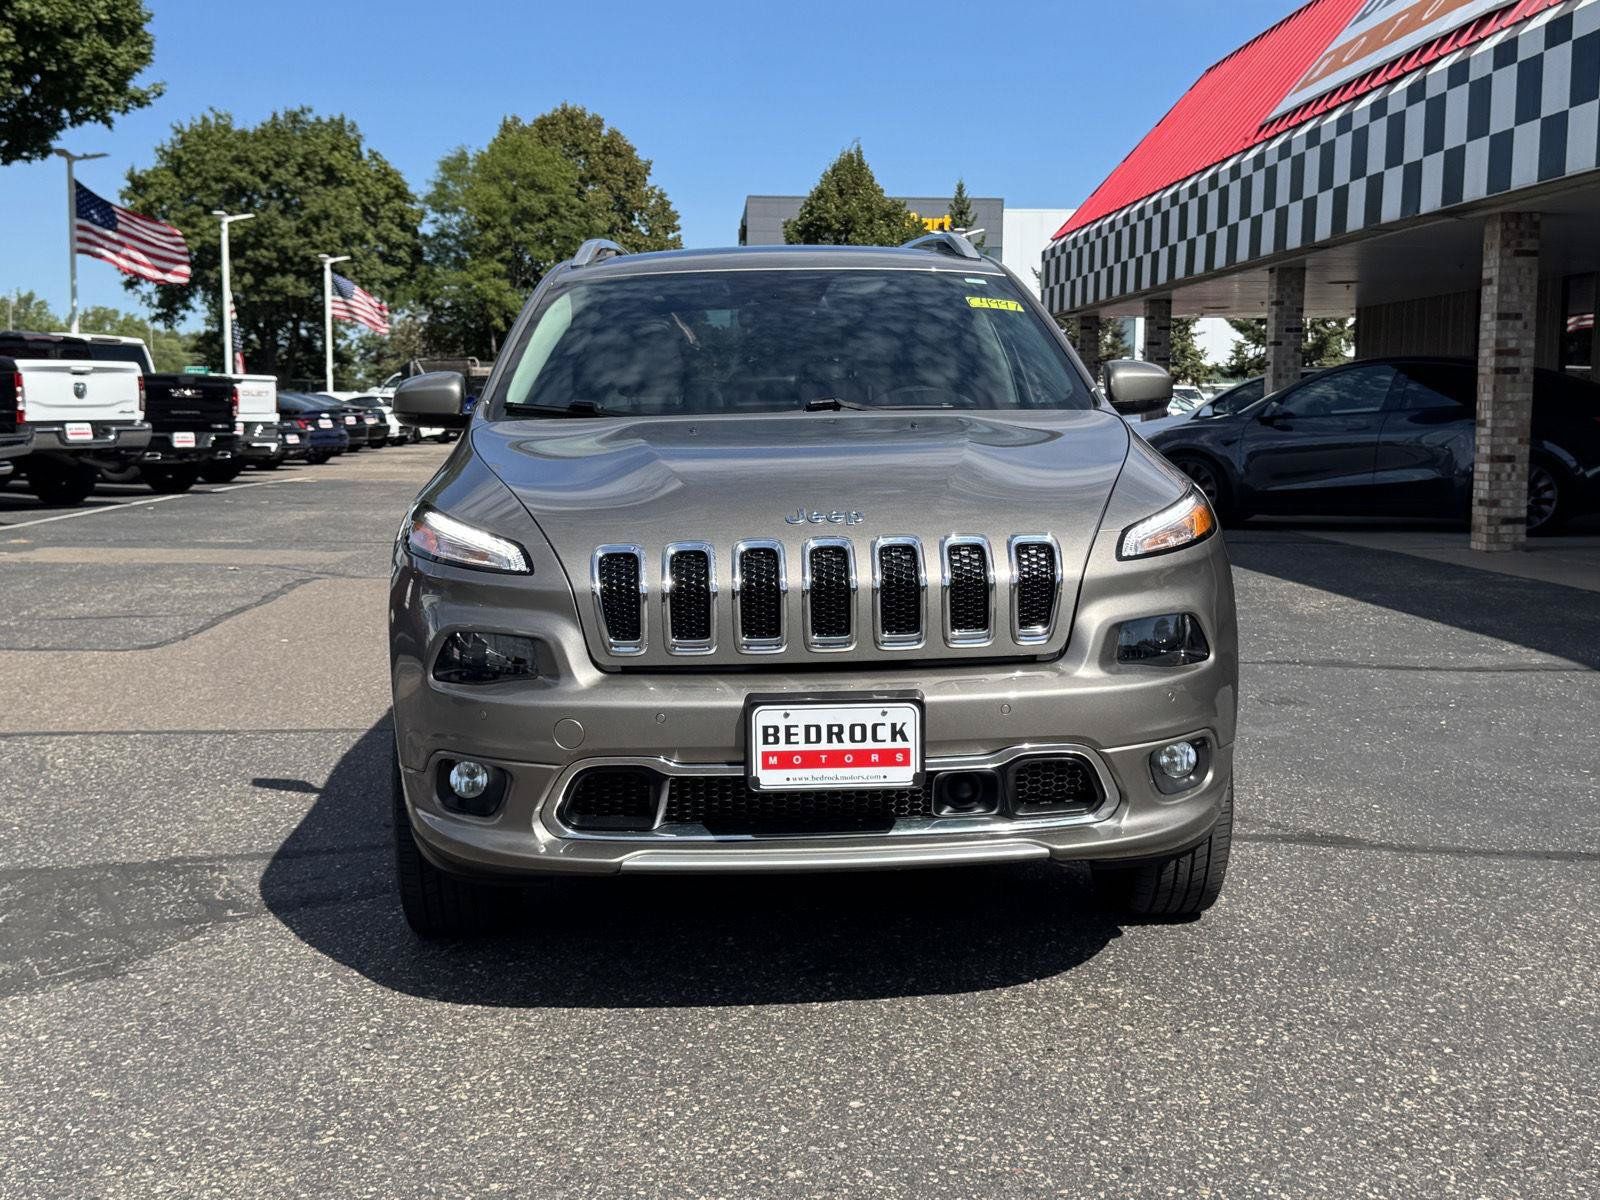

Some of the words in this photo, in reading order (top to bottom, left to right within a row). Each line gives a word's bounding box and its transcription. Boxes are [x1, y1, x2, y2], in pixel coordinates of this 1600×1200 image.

[785, 506, 865, 526] Jeep
[762, 722, 909, 746] BEDROCK
[768, 753, 904, 765] MOTORS
[791, 774, 881, 782] www.bedrockmotors.com
